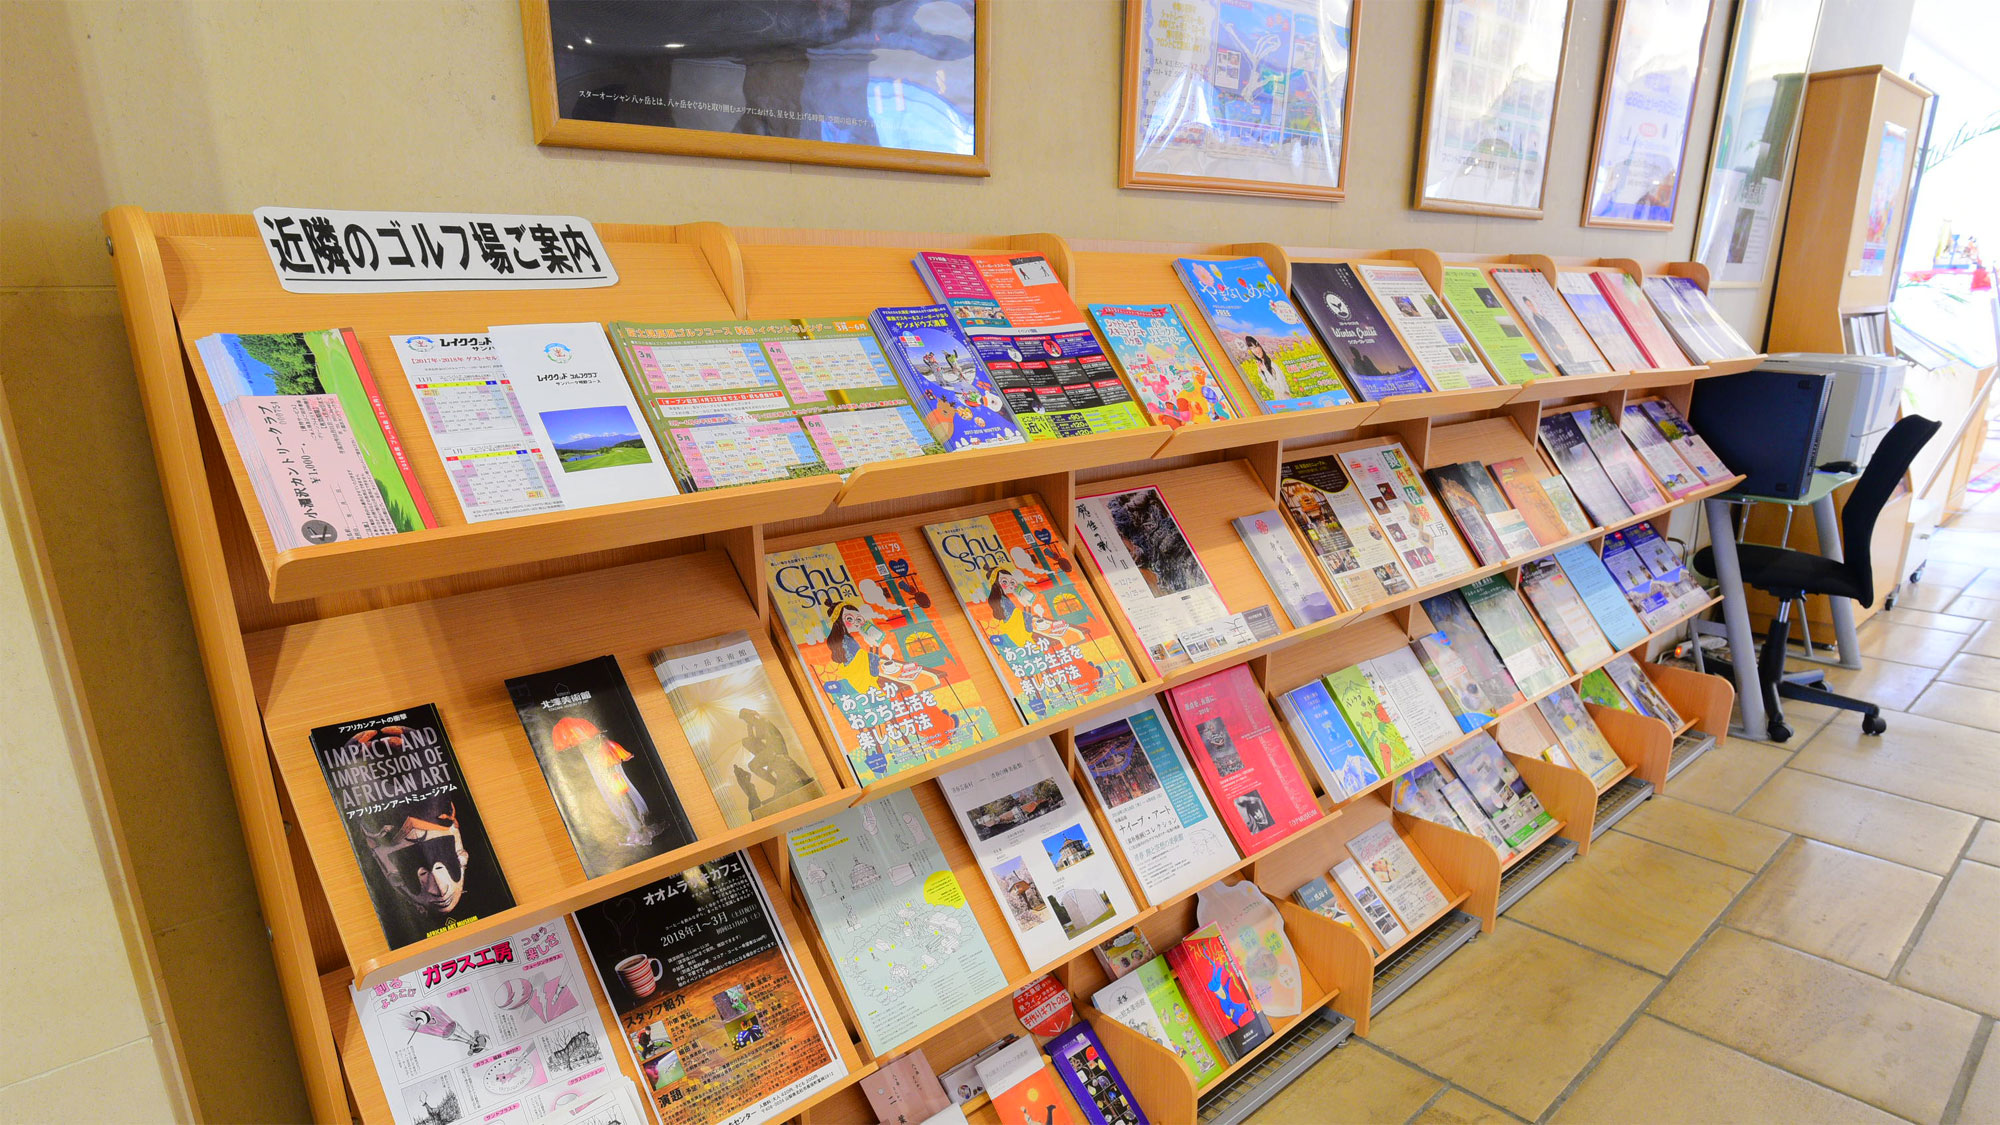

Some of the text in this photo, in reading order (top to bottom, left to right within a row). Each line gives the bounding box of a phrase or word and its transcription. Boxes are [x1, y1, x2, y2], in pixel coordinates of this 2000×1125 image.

[263, 216, 602, 275] 近隣のゴルフ場ご案内
[638, 351, 651, 359] 3月
[677, 433, 690, 442] 5月
[808, 420, 821, 428] 6月
[889, 543, 900, 554] 79
[942, 534, 1002, 558] Chu
[776, 565, 850, 593] Chu
[681, 649, 747, 671] 八ヶ岳美術館
[1004, 638, 1050, 661] あったか
[1012, 645, 1083, 677] おうち生活を
[1020, 665, 1081, 695] 楽しむ方法
[841, 682, 898, 711] あったか
[849, 691, 937, 730] おうち生活を
[338, 713, 407, 733] アフリカンアートの衝撃
[857, 713, 933, 750] 楽しむ方法
[324, 726, 438, 770] IMPACT AND
[331, 746, 444, 788] IMPRESSION OF
[342, 763, 451, 809] AFRICAN ART
[346, 783, 458, 819] アフリカンアートミュージアム
[1119, 805, 1171, 835] ナイーブ・アート
[426, 925, 447, 938] AFRICAN
[457, 915, 478, 929] MUSEUM
[525, 933, 560, 960] 楽しさ
[423, 941, 513, 988] ガラス工房
[624, 994, 685, 1028] スタッフ紹介
[657, 1089, 683, 1109] 演題
